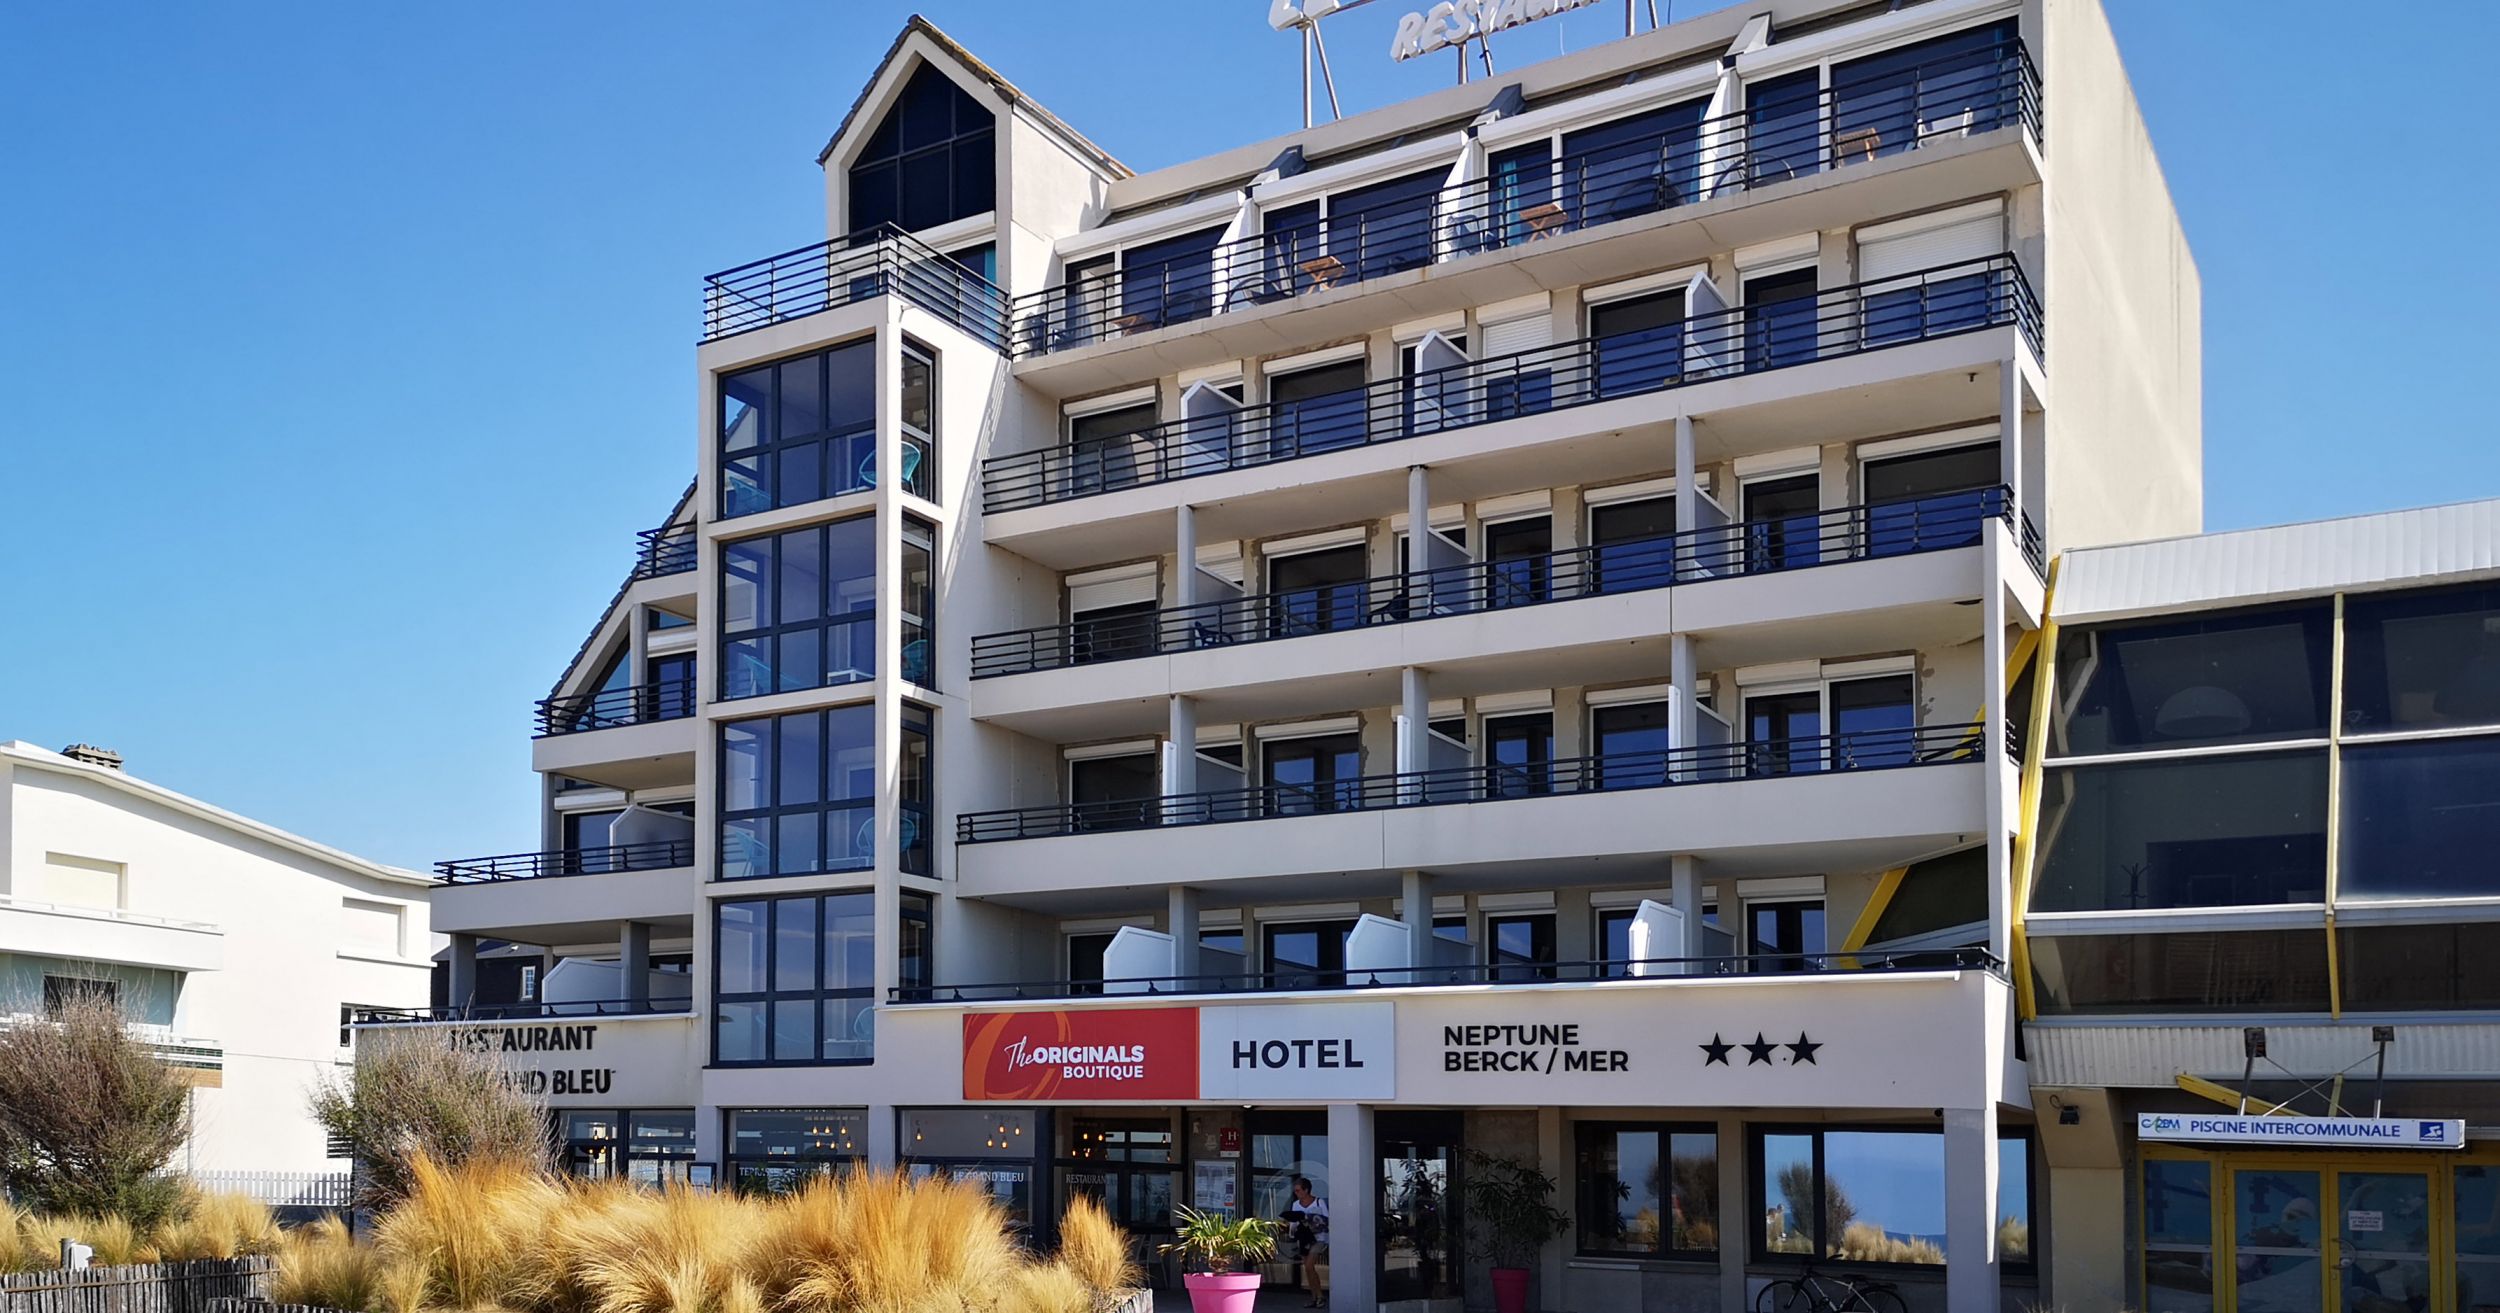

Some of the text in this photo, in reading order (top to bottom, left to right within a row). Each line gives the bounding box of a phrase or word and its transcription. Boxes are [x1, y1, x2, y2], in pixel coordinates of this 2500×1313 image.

[1444, 1024, 1579, 1046] NEPTUNE
[1004, 1036, 1144, 1072] The ORIGINALS
[1232, 1039, 1364, 1069] HOTEL
[553, 1069, 612, 1094] BLEU
[1063, 1066, 1144, 1080] BOUTIQUE
[2191, 1120, 2248, 1133] PISCINE
[2251, 1121, 2400, 1137] INTERCOMMUNALE
[1000, 1171, 1024, 1183] BLEU
[1065, 1174, 1111, 1184] RESTAURAN
